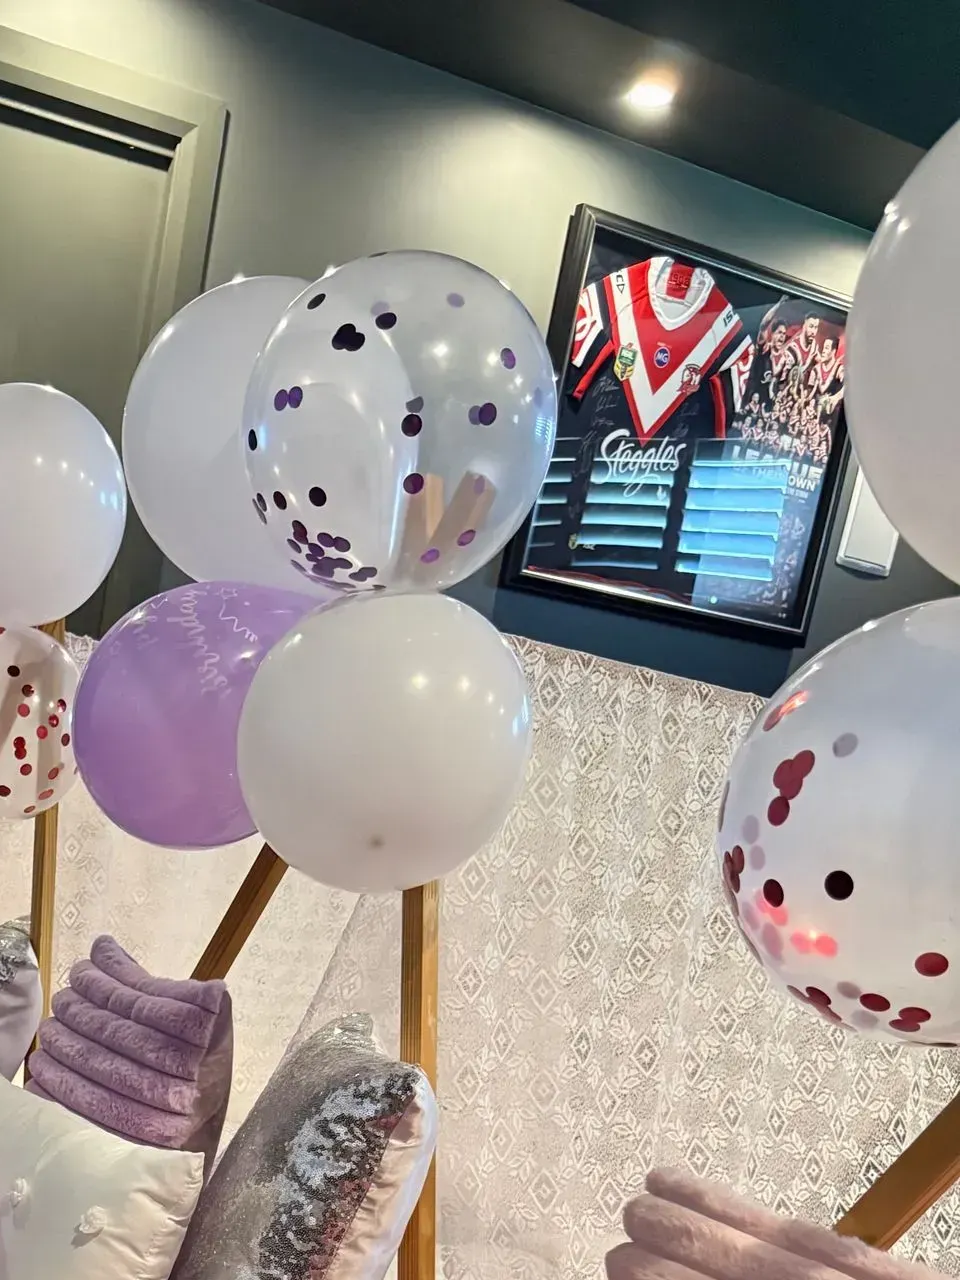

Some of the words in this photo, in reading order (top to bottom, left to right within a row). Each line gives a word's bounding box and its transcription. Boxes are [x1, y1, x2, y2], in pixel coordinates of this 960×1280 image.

[655, 352, 668, 363] MG
[601, 429, 687, 497] Steggles
[731, 445, 823, 479] LEAUE
[788, 475, 816, 492] OWN
